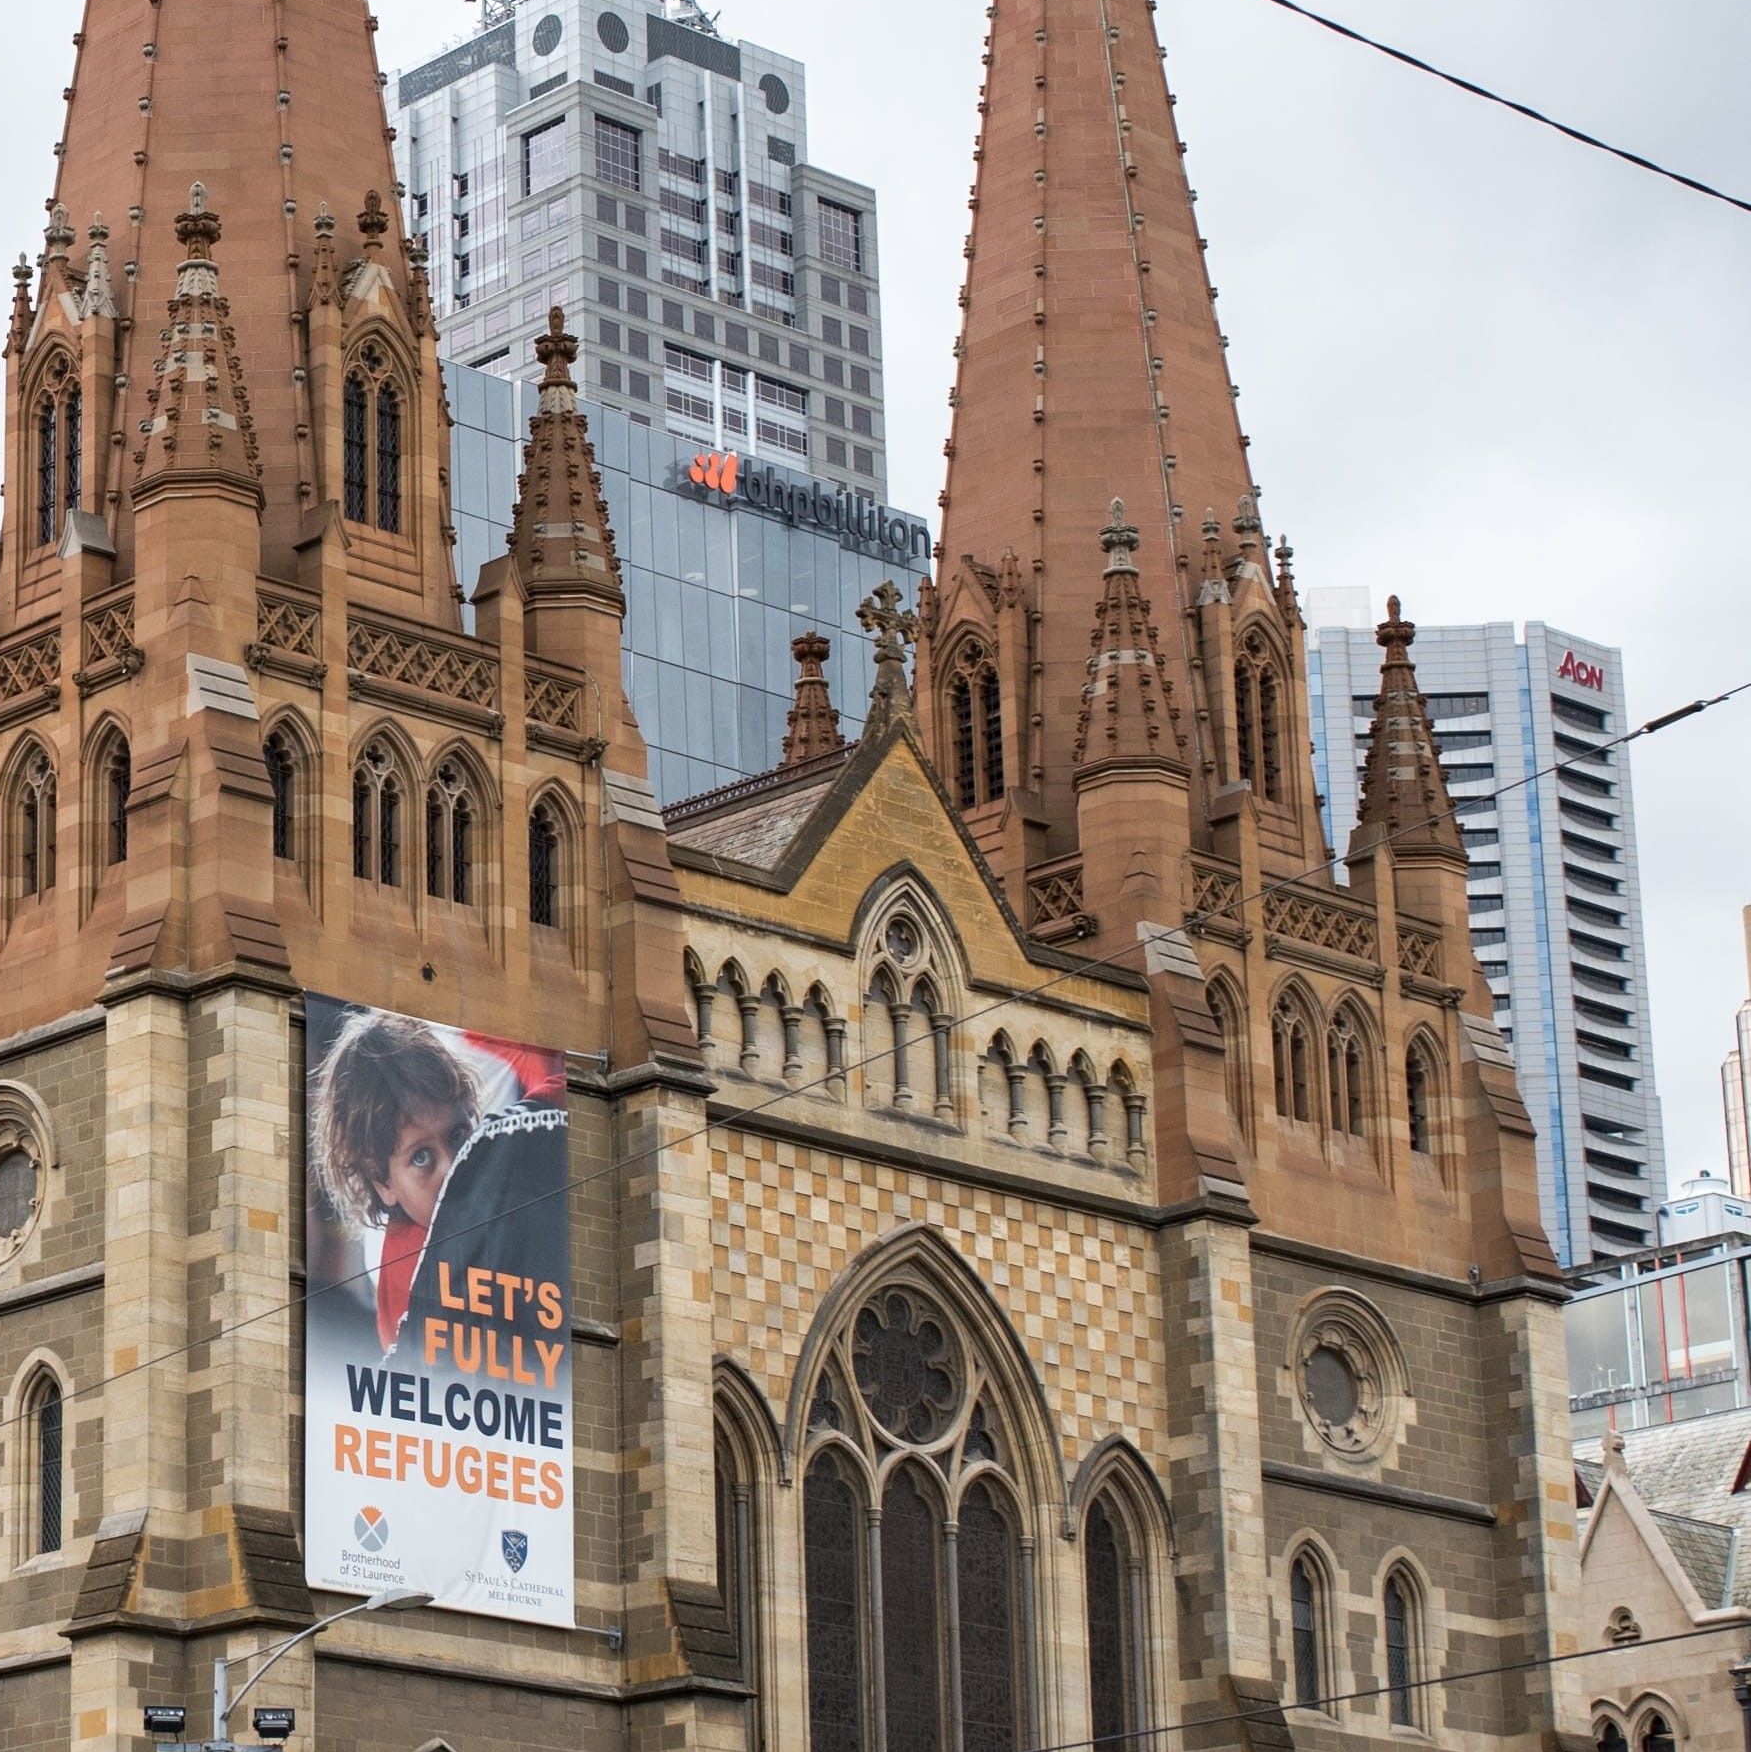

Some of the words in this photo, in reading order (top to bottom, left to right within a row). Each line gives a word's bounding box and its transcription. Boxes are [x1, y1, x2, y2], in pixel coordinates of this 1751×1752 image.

[743, 458, 932, 560] bhpbilliton
[1556, 649, 1603, 692] AON
[438, 1261, 563, 1330] LET'S
[424, 1317, 564, 1389] FULLY
[346, 1364, 564, 1450] WELCOME
[334, 1423, 564, 1510] REFUGEES
[339, 1564, 351, 1576] of
[352, 1565, 361, 1577] St
[363, 1567, 405, 1585] Laurence
[341, 1549, 401, 1570] Brotherhood
[487, 1589, 543, 1608] MELBOURNE
